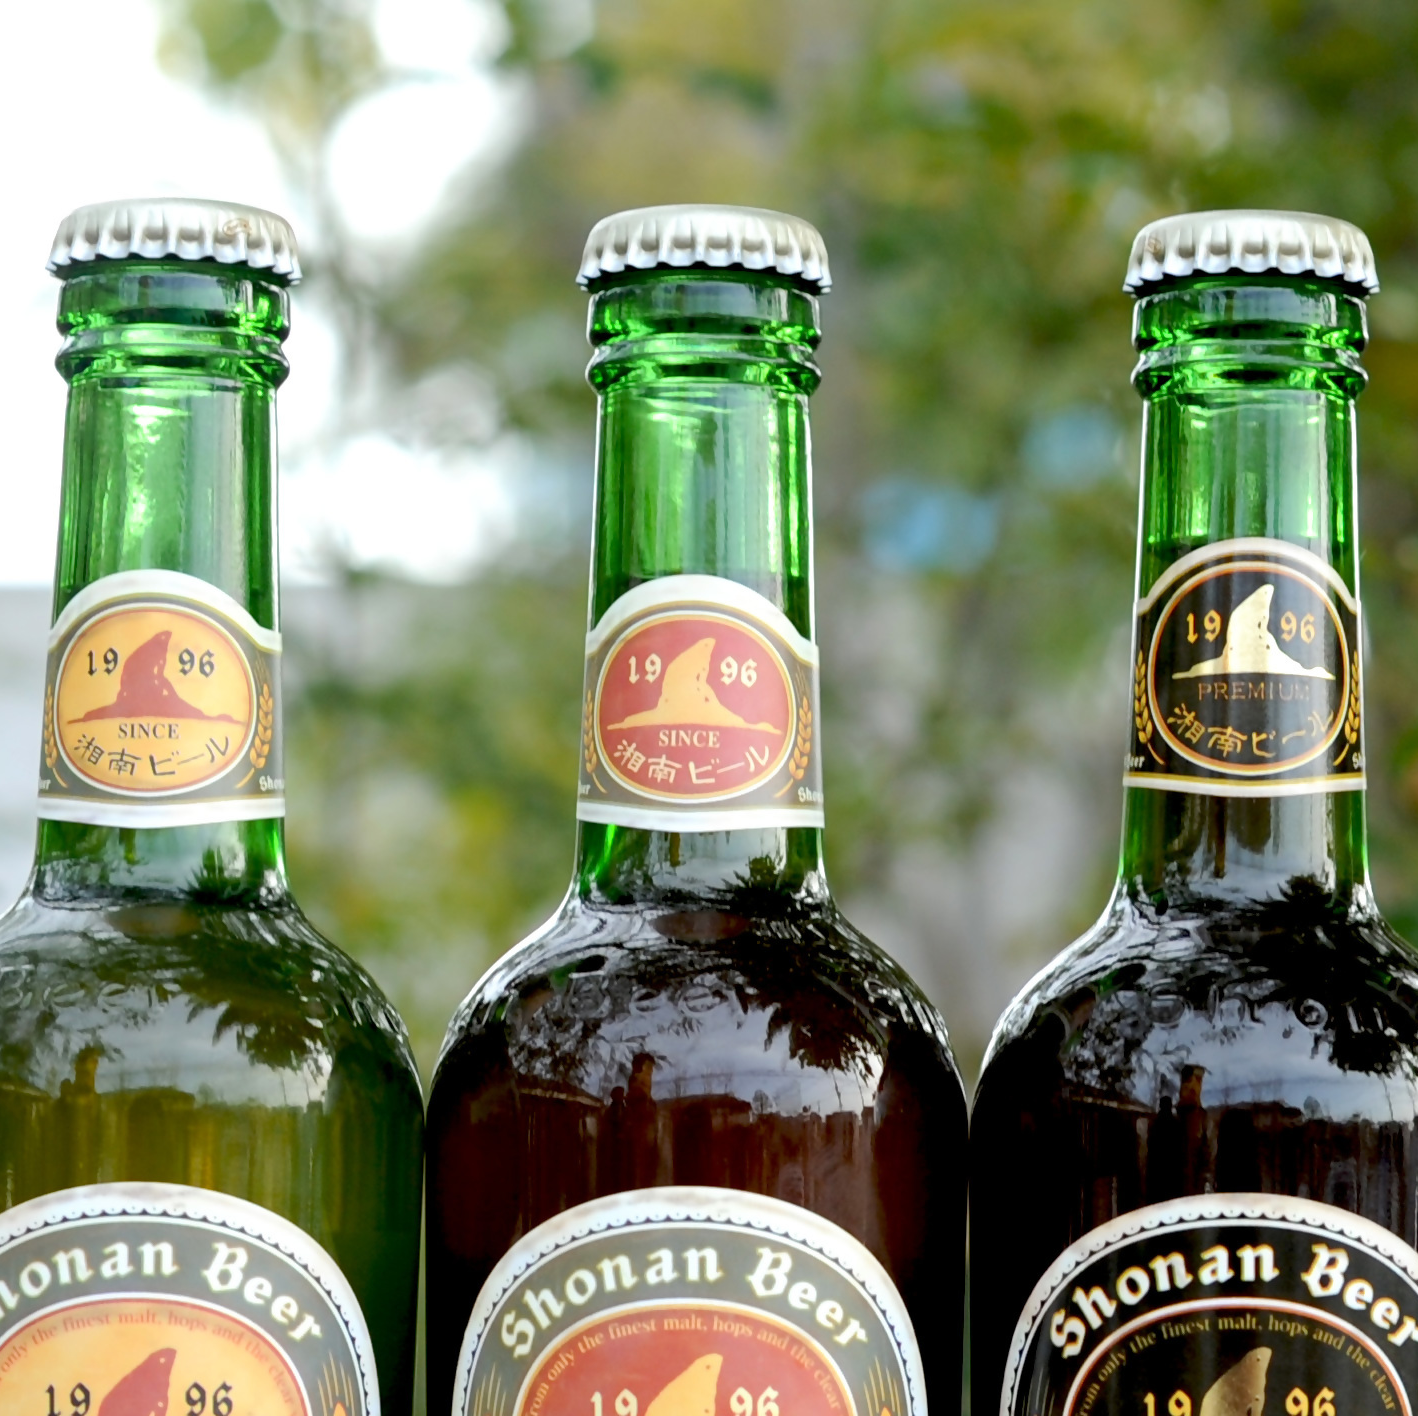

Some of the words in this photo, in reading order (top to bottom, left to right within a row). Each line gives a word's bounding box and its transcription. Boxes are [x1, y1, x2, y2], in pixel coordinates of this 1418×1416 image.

[1187, 609, 1221, 644] 19
[1281, 611, 1315, 644] 96
[88, 648, 118, 676] 19
[179, 648, 215, 677] 96
[628, 653, 662, 684] 19
[720, 656, 757, 688] 96
[1198, 682, 1309, 701] PREMIUM
[118, 723, 179, 739] SINCE
[659, 730, 720, 747] SINCE
[1167, 703, 1334, 758] 湘南ビール
[74, 733, 229, 775] 湘南ビール
[614, 739, 769, 784] 湘南ビール
[202, 1242, 323, 1341] Beer
[501, 1246, 722, 1359] Shonan
[746, 1247, 868, 1346] Beer
[1050, 1243, 1280, 1360] Shonan
[548, 1349, 574, 1382] only
[578, 1333, 604, 1353] the
[608, 1318, 656, 1340] finest
[713, 1315, 753, 1337] hops
[757, 1328, 789, 1350] and
[790, 1345, 815, 1369] the
[813, 1369, 841, 1408] clear
[1098, 1349, 1127, 1382] only
[1130, 1332, 1156, 1353] the
[1161, 1318, 1210, 1340] finest
[1269, 1315, 1308, 1337] hops
[1313, 1328, 1346, 1350] and
[1346, 1344, 1370, 1369] the
[1370, 1369, 1396, 1410] clear
